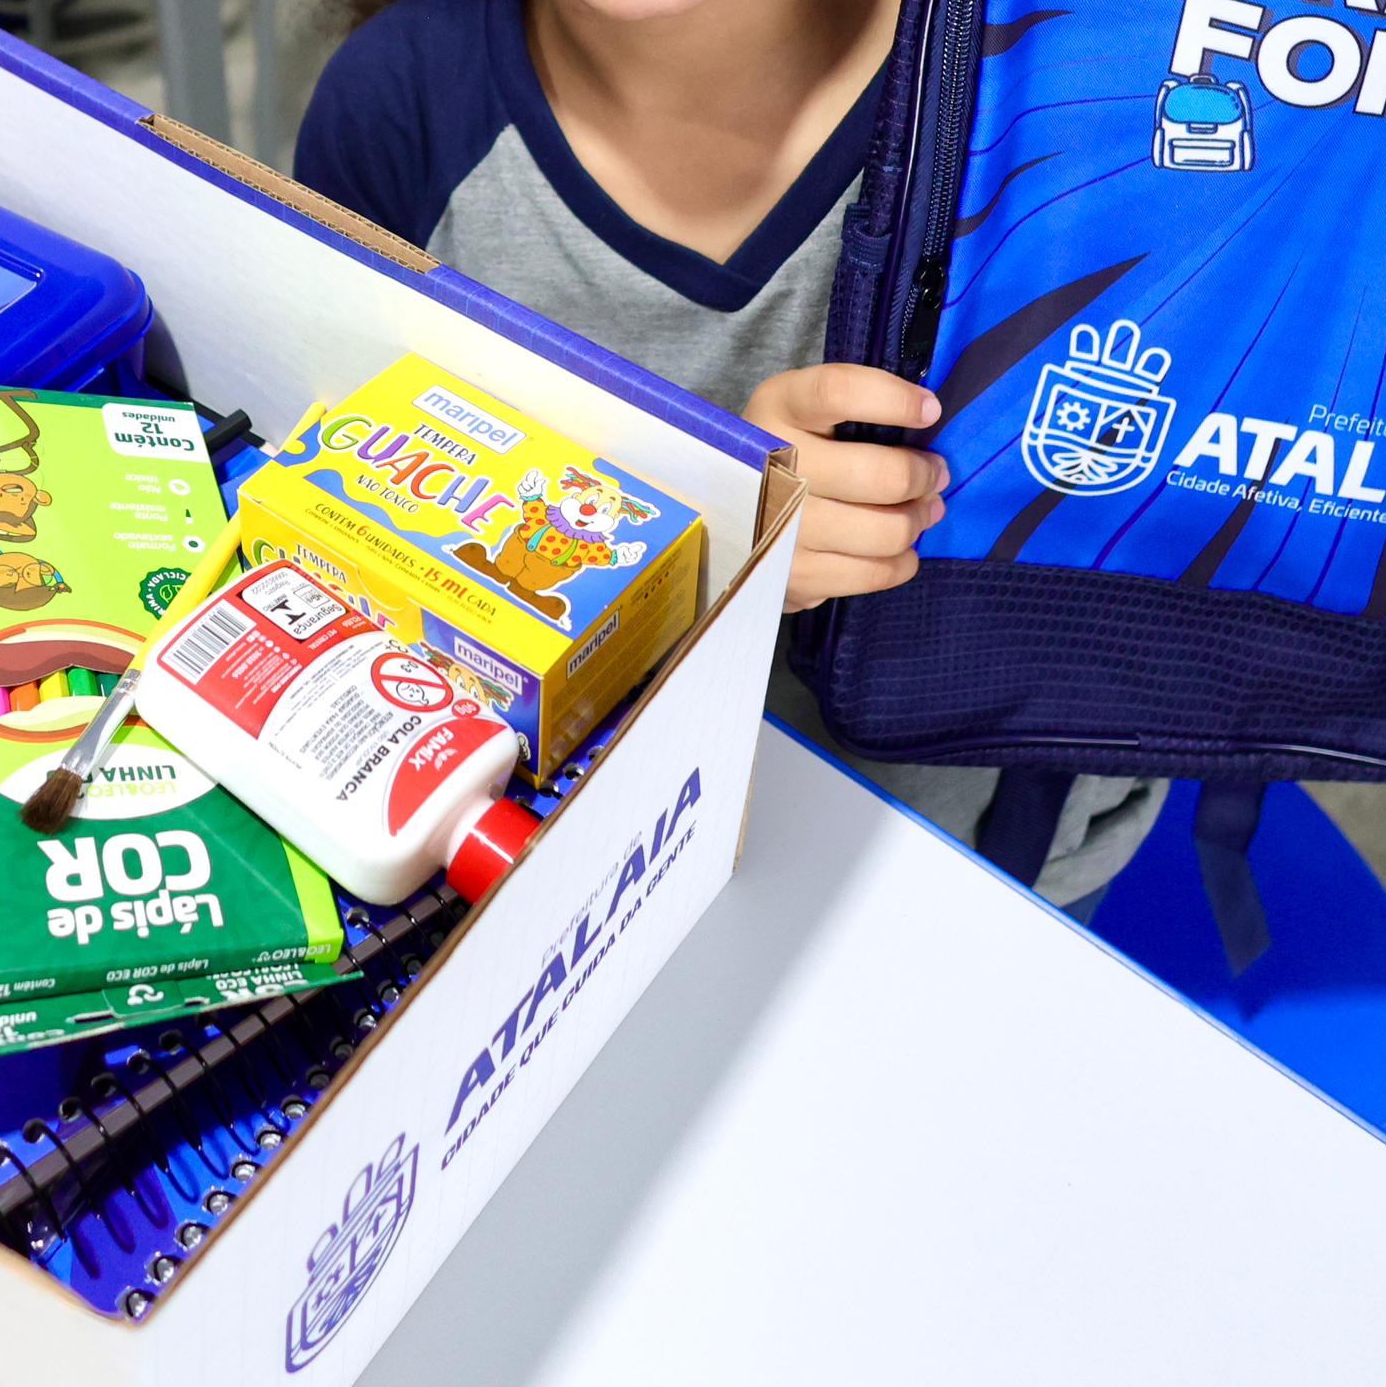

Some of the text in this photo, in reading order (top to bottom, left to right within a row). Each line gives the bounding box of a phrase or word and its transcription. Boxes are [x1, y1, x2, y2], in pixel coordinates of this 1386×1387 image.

[122, 411, 175, 424] unidades
[141, 421, 164, 434] 12
[423, 389, 519, 447] maripel
[114, 432, 195, 453] Contém
[413, 423, 477, 466] TEMPERA
[321, 416, 515, 533] GUACHE
[1166, 470, 1230, 497] Cidade
[1232, 484, 1303, 513] Afetiva,
[356, 523, 368, 537] 6
[365, 532, 418, 569] UNIDADES
[423, 565, 442, 587] 15
[467, 594, 498, 617] CADA
[291, 600, 341, 636] Segurança
[456, 641, 519, 688] maripel
[569, 618, 617, 673] maripel
[101, 764, 177, 784] LINHA
[334, 713, 423, 803] COLA BRANCA
[37, 830, 212, 902] COR
[47, 892, 223, 945] Lápis de
[541, 830, 643, 968] Prefeitura de
[166, 962, 177, 974] de
[178, 958, 209, 974] Lápis
[271, 944, 332, 961] LEO&LEO
[444, 766, 702, 1136] ATALAIA
[14, 978, 56, 993] Contém
[107, 968, 134, 982] ECO
[136, 965, 164, 980] COR
[215, 976, 247, 991] ECO
[248, 967, 303, 987] LINHA
[441, 818, 698, 1171] CIDADE QUE CUIDA DA GENTE
